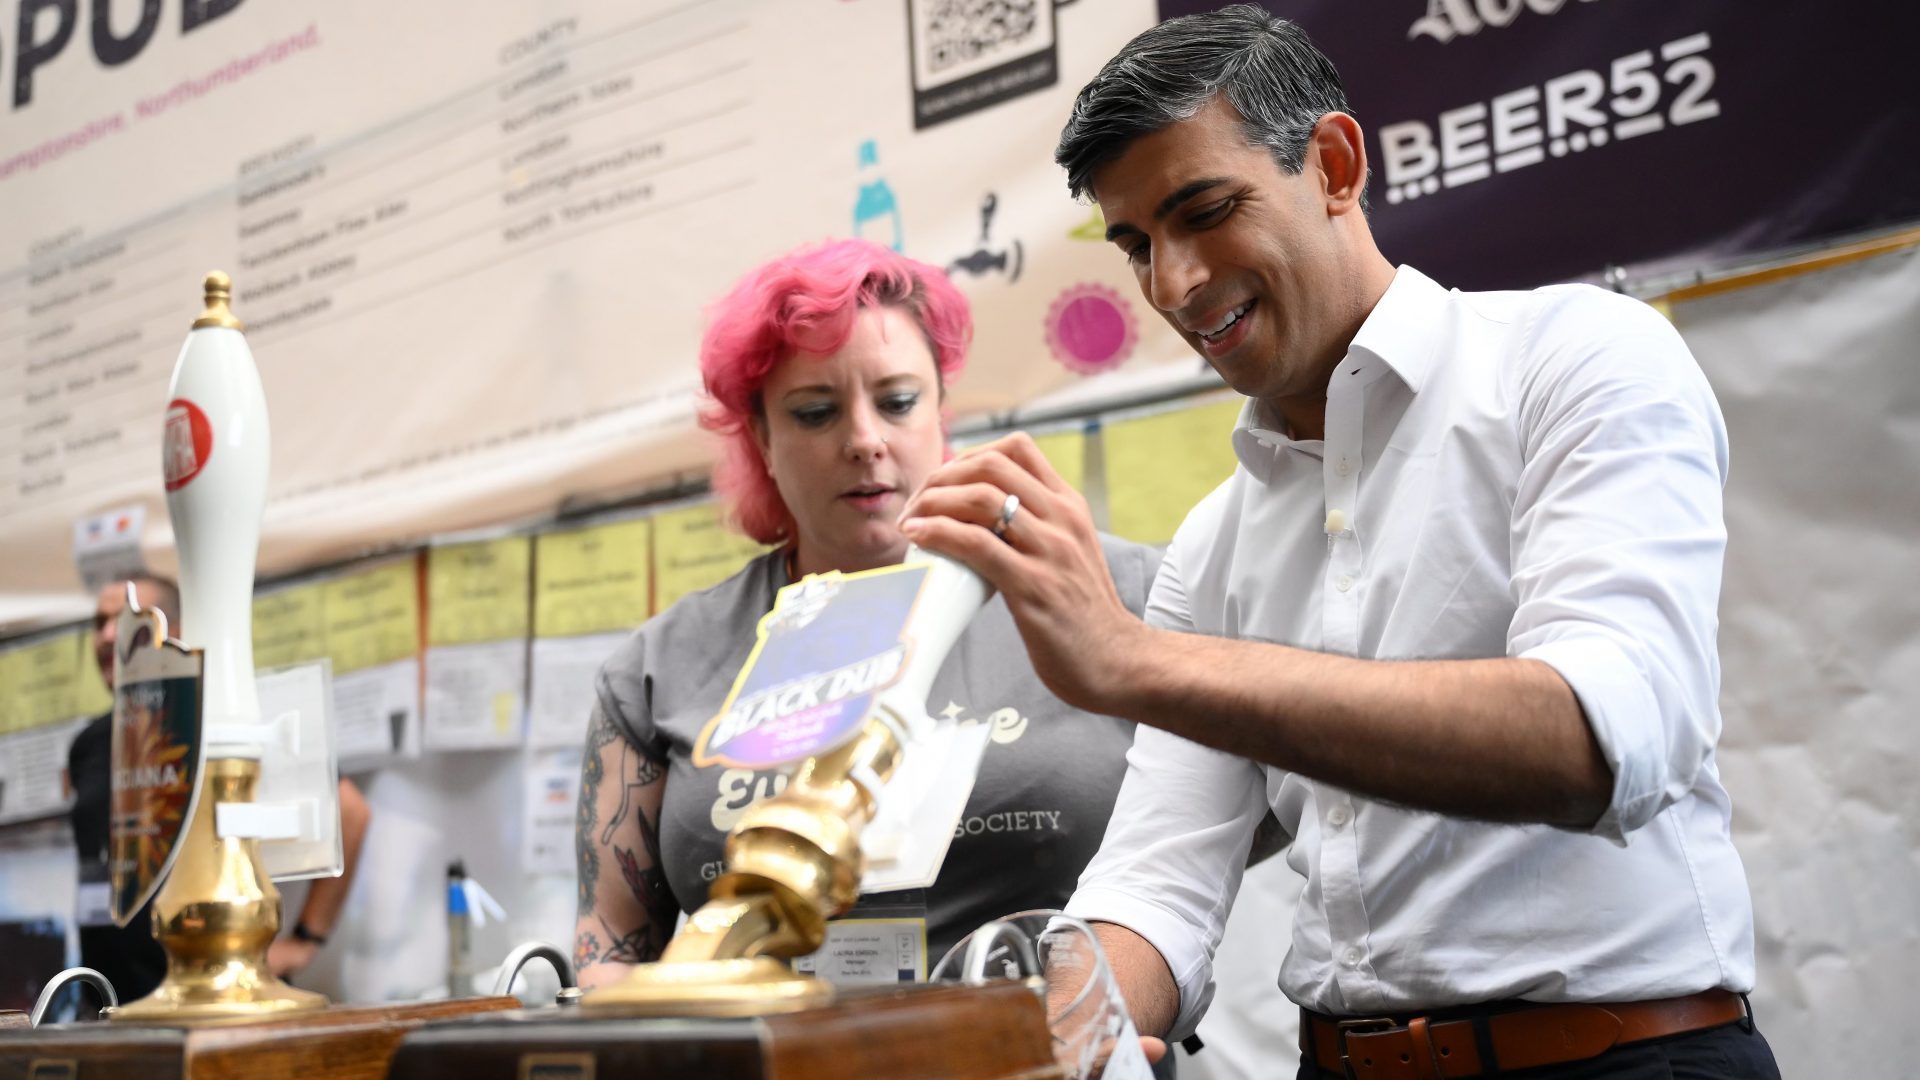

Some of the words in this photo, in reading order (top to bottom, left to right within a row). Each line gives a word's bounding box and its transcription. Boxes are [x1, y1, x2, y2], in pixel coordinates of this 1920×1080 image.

[1378, 34, 1721, 202] BEER52
[710, 671, 832, 750] BLACK
[954, 810, 1061, 838] SOCIETY
